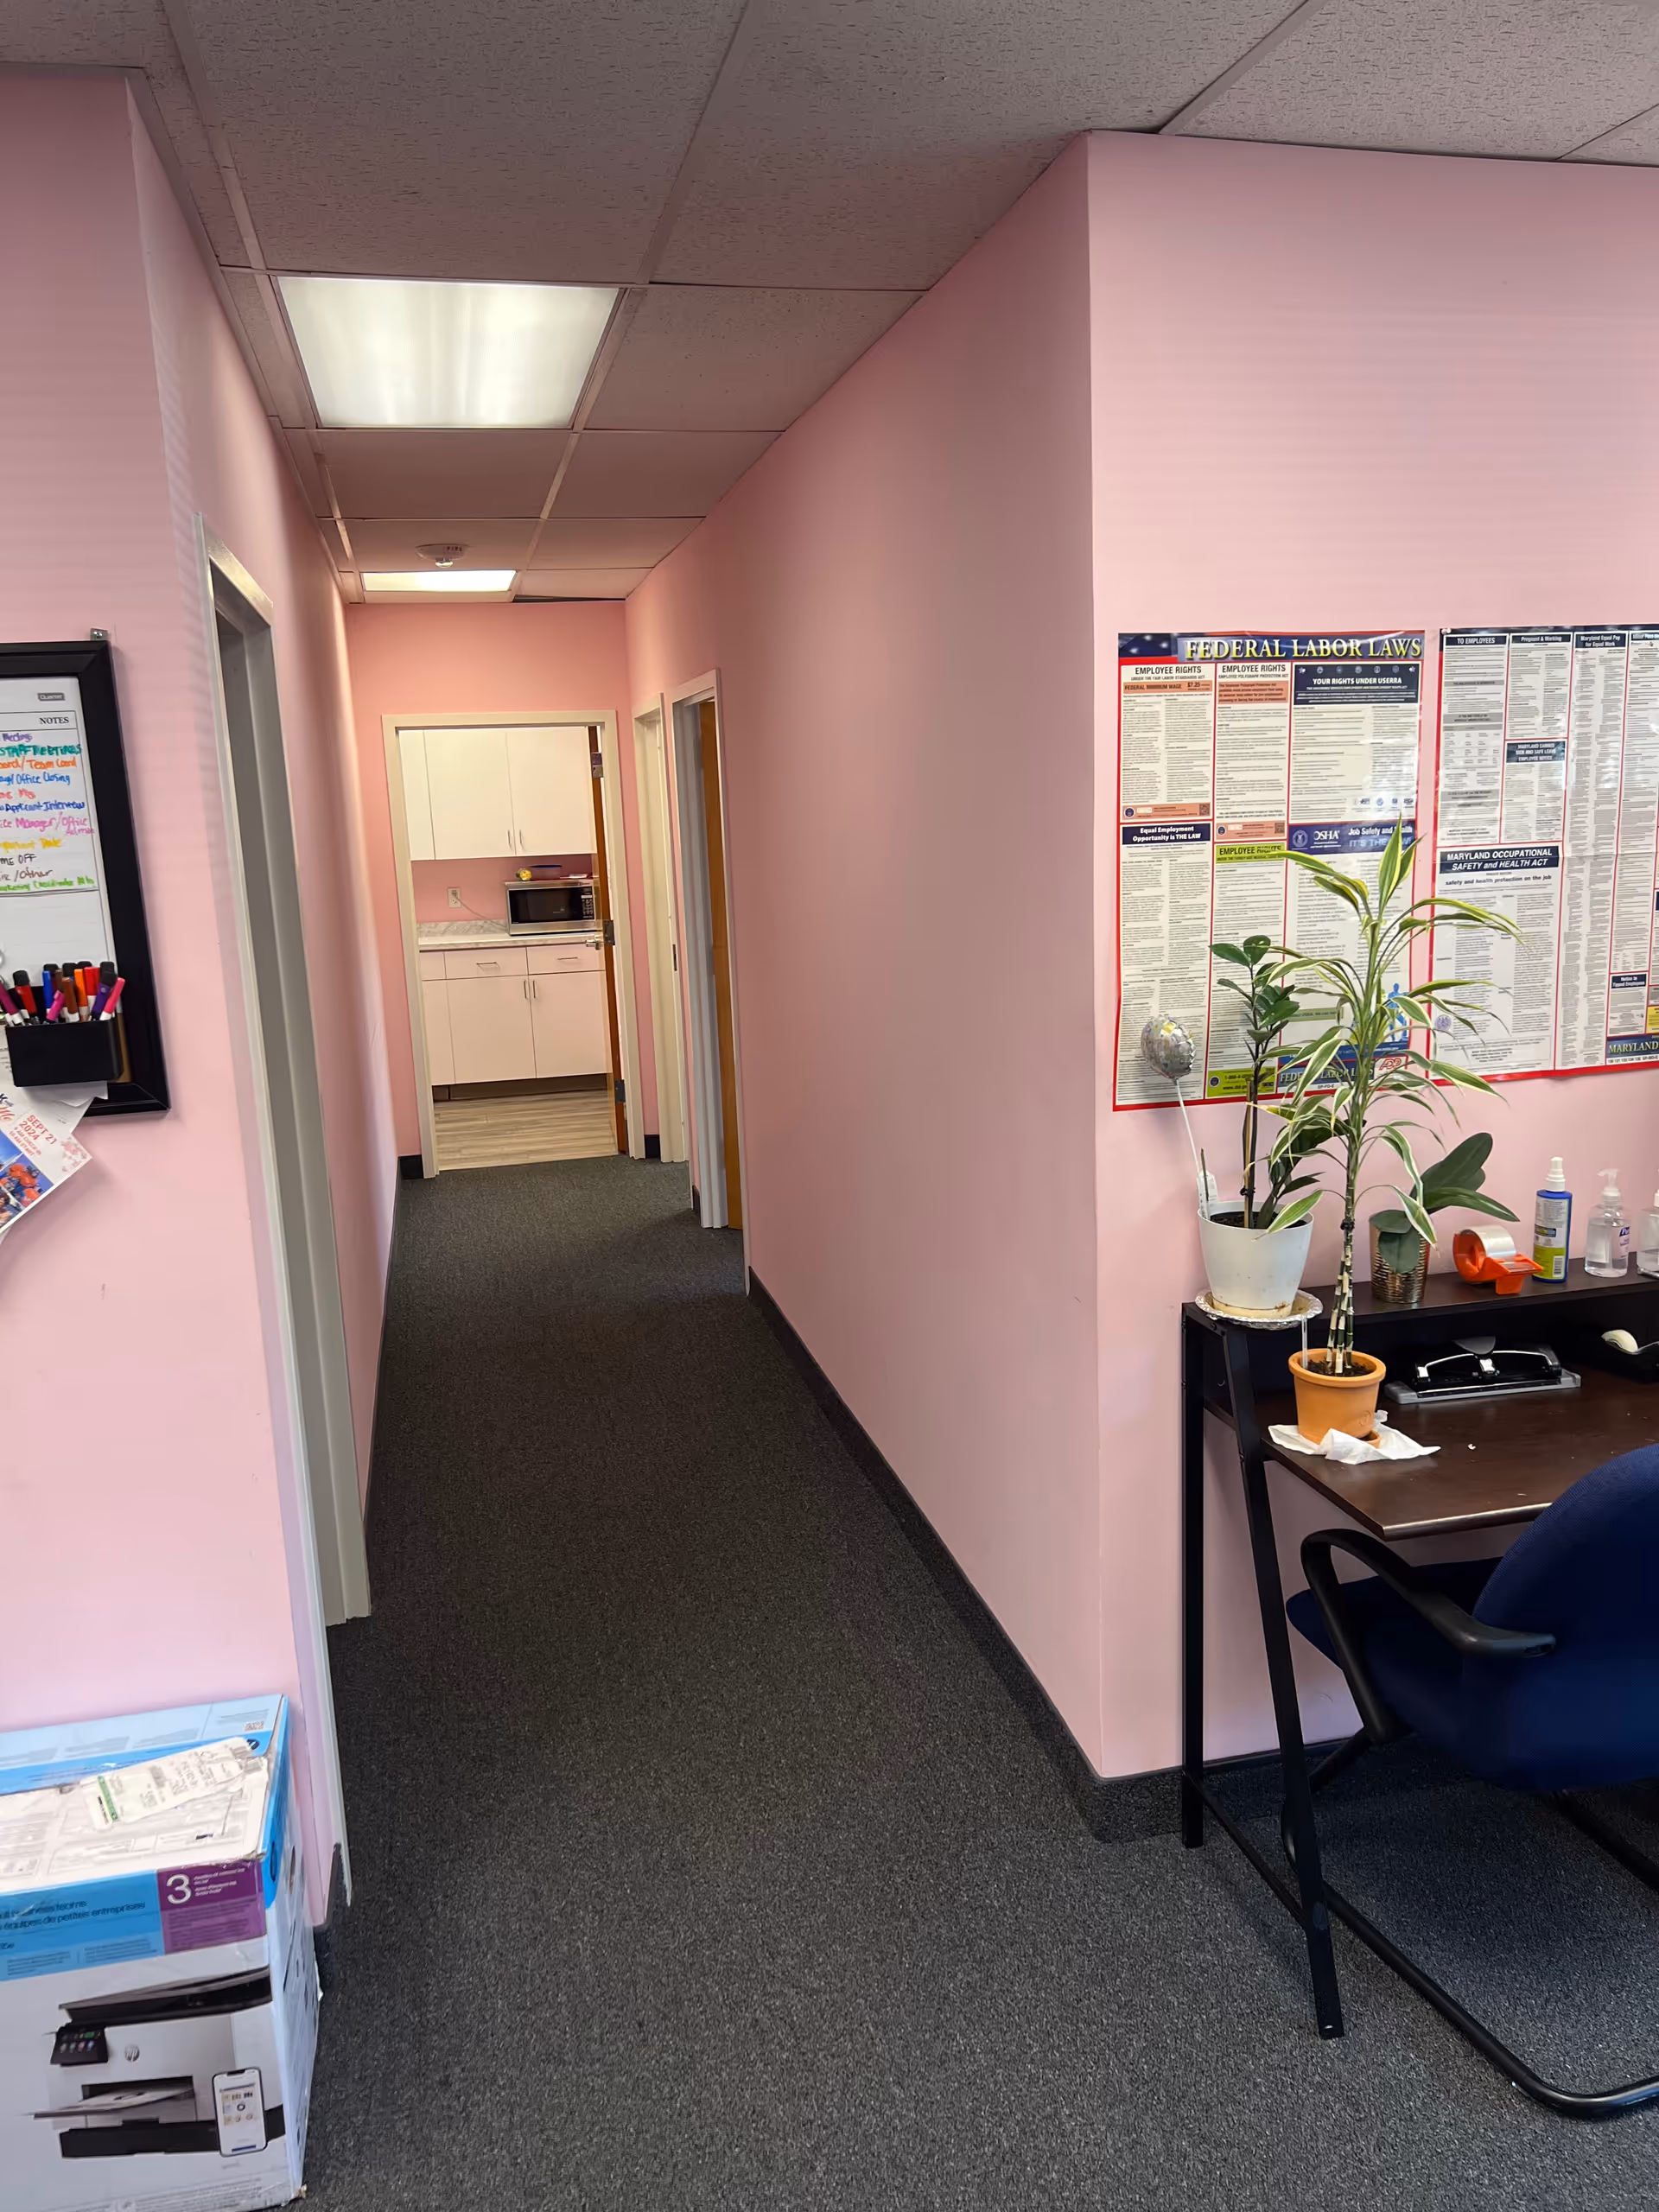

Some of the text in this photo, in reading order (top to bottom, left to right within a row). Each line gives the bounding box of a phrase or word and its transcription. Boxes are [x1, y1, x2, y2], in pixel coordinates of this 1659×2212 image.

[1185, 638, 1421, 659] FEDERAL LABOR LAWS
[1222, 664, 1259, 673] EMPLOYEE
[1348, 827, 1360, 836] Job
[1361, 826, 1381, 836] Safety
[1382, 826, 1392, 835] and
[1219, 847, 1255, 855] EMPLOYEE
[1446, 849, 1553, 861] MARYLAND OCCUPATIONAL
[18, 853, 37, 865] OFF
[1452, 858, 1548, 871] SAFETY and HEALTH ACT
[1609, 1041, 1659, 1053] MARYLAND
[1380, 1058, 1402, 1070] ADP
[19, 1120, 41, 1141] 2024
[27, 1115, 58, 1145] SEPT 21
[166, 1873, 192, 1905] 3
[55, 1900, 87, 1911] teams
[43, 1915, 56, 1924] de
[57, 1910, 90, 1924] petites
[91, 1901, 146, 1917] entreprises
